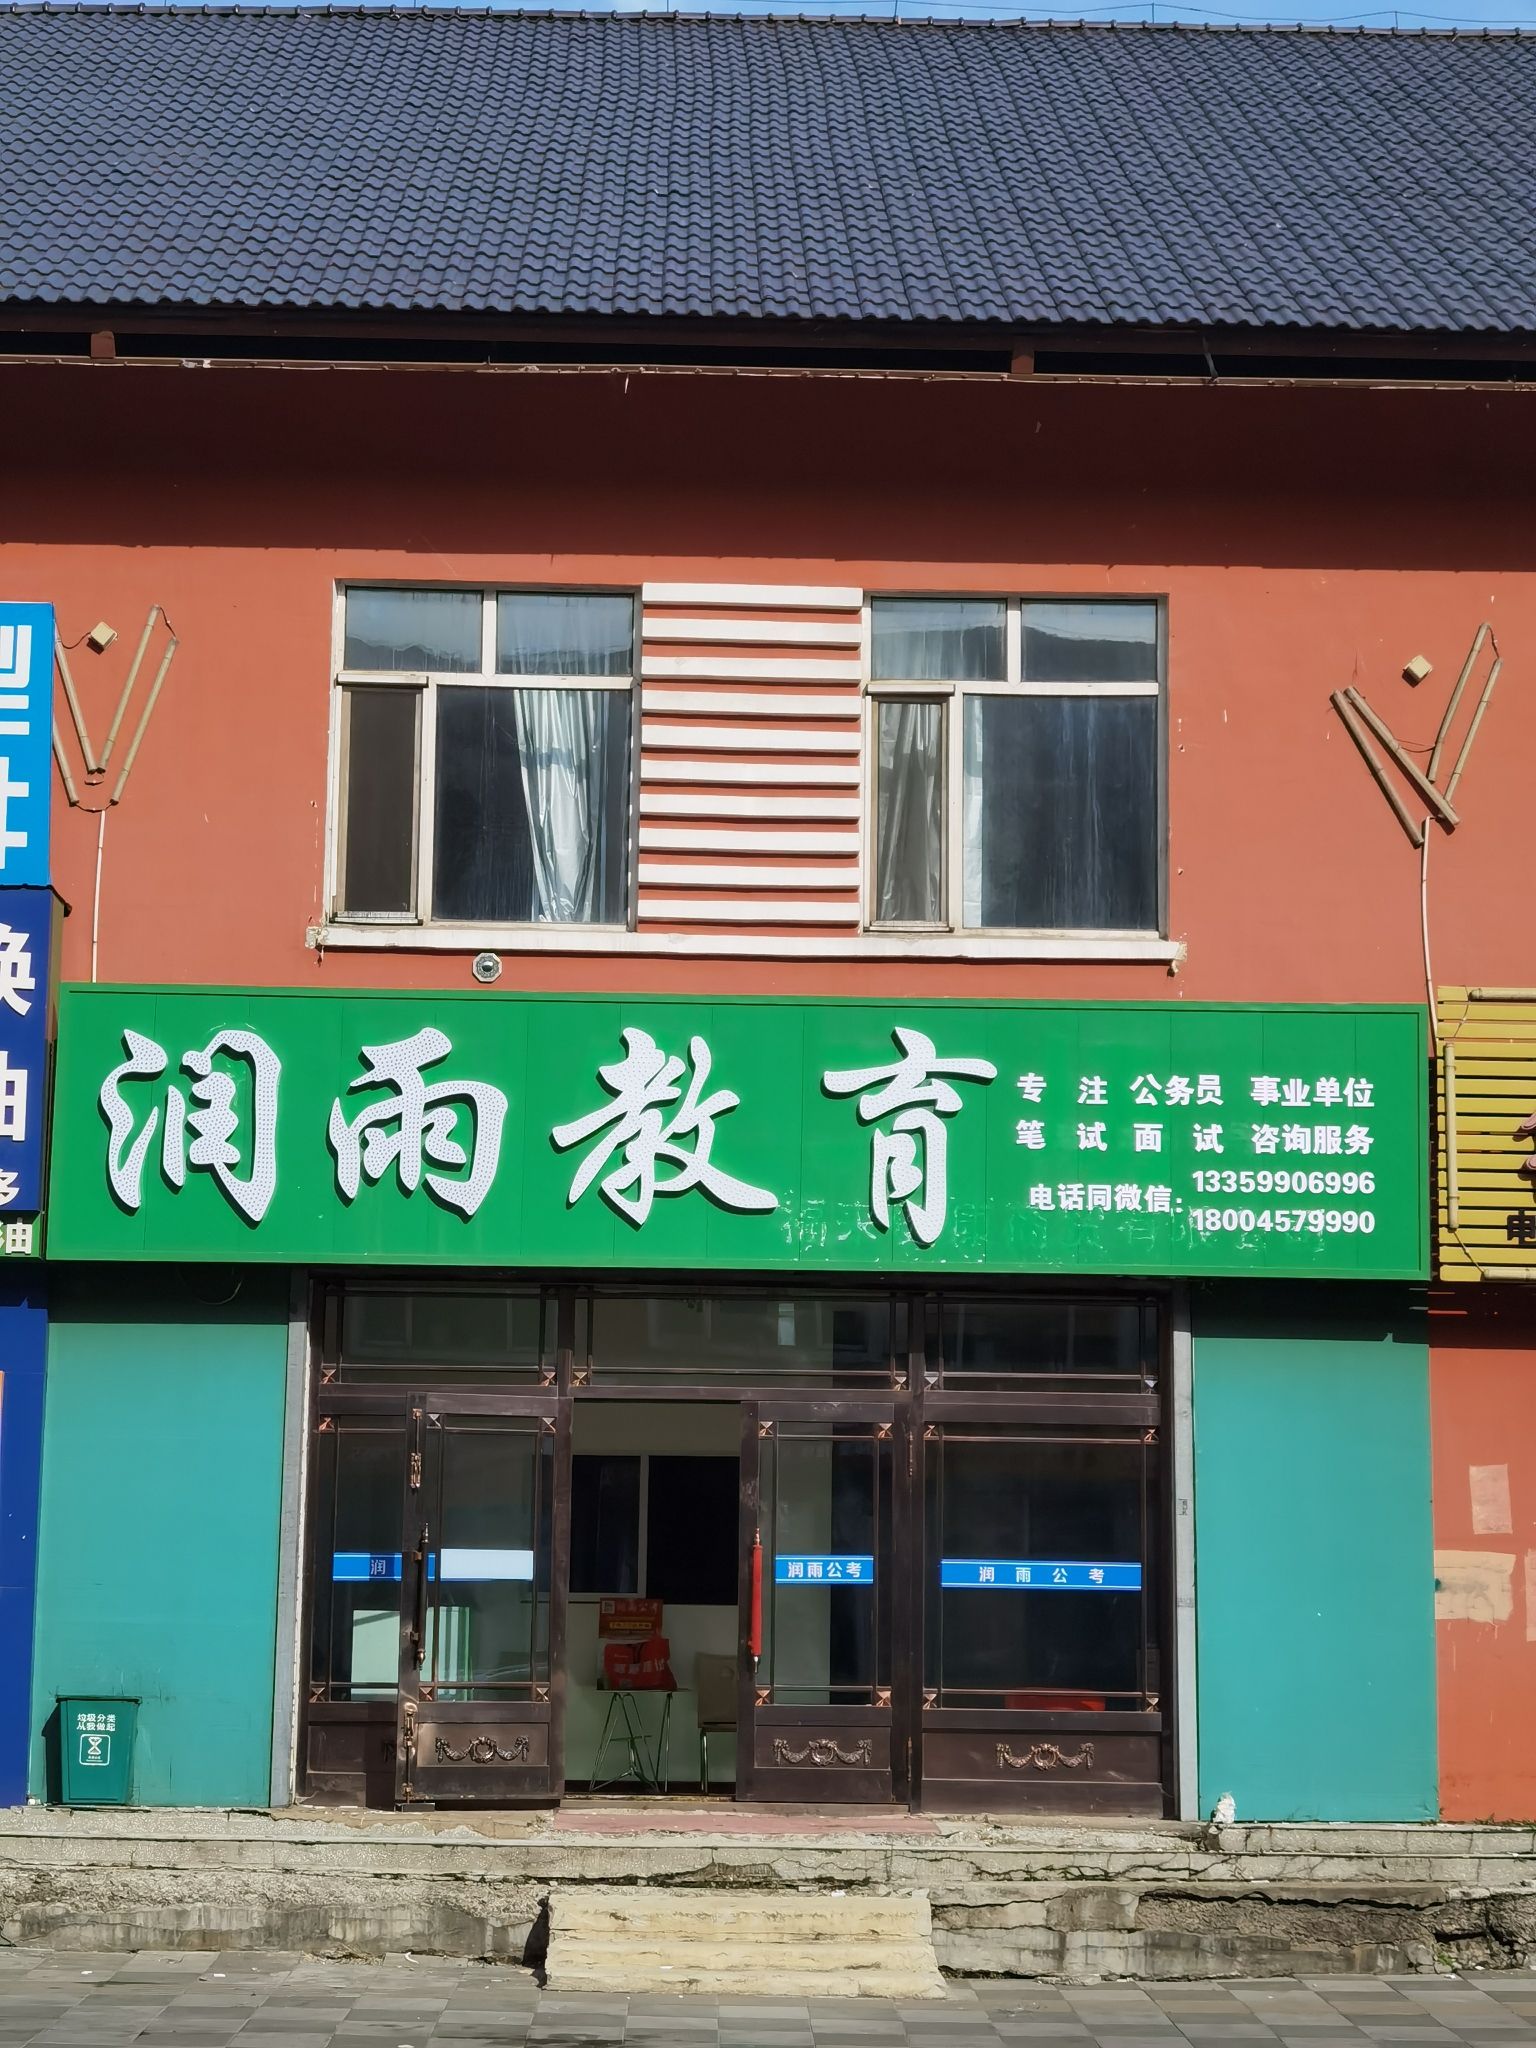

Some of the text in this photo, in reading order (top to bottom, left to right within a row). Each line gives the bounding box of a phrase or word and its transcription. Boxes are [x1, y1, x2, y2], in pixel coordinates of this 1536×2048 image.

[1129, 1073, 1224, 1106] 公务员
[1250, 1075, 1375, 1107] 事业单位
[99, 1026, 998, 1246] 润雨教育
[1250, 1123, 1374, 1155] 咨询服务
[1192, 1170, 1376, 1195] 13359906996
[1192, 1208, 1376, 1234] 18004579990
[787, 1560, 863, 1579] 润雨公考
[979, 1566, 1105, 1584] 润雨公考
[77, 1713, 116, 1723] 垃圾分类
